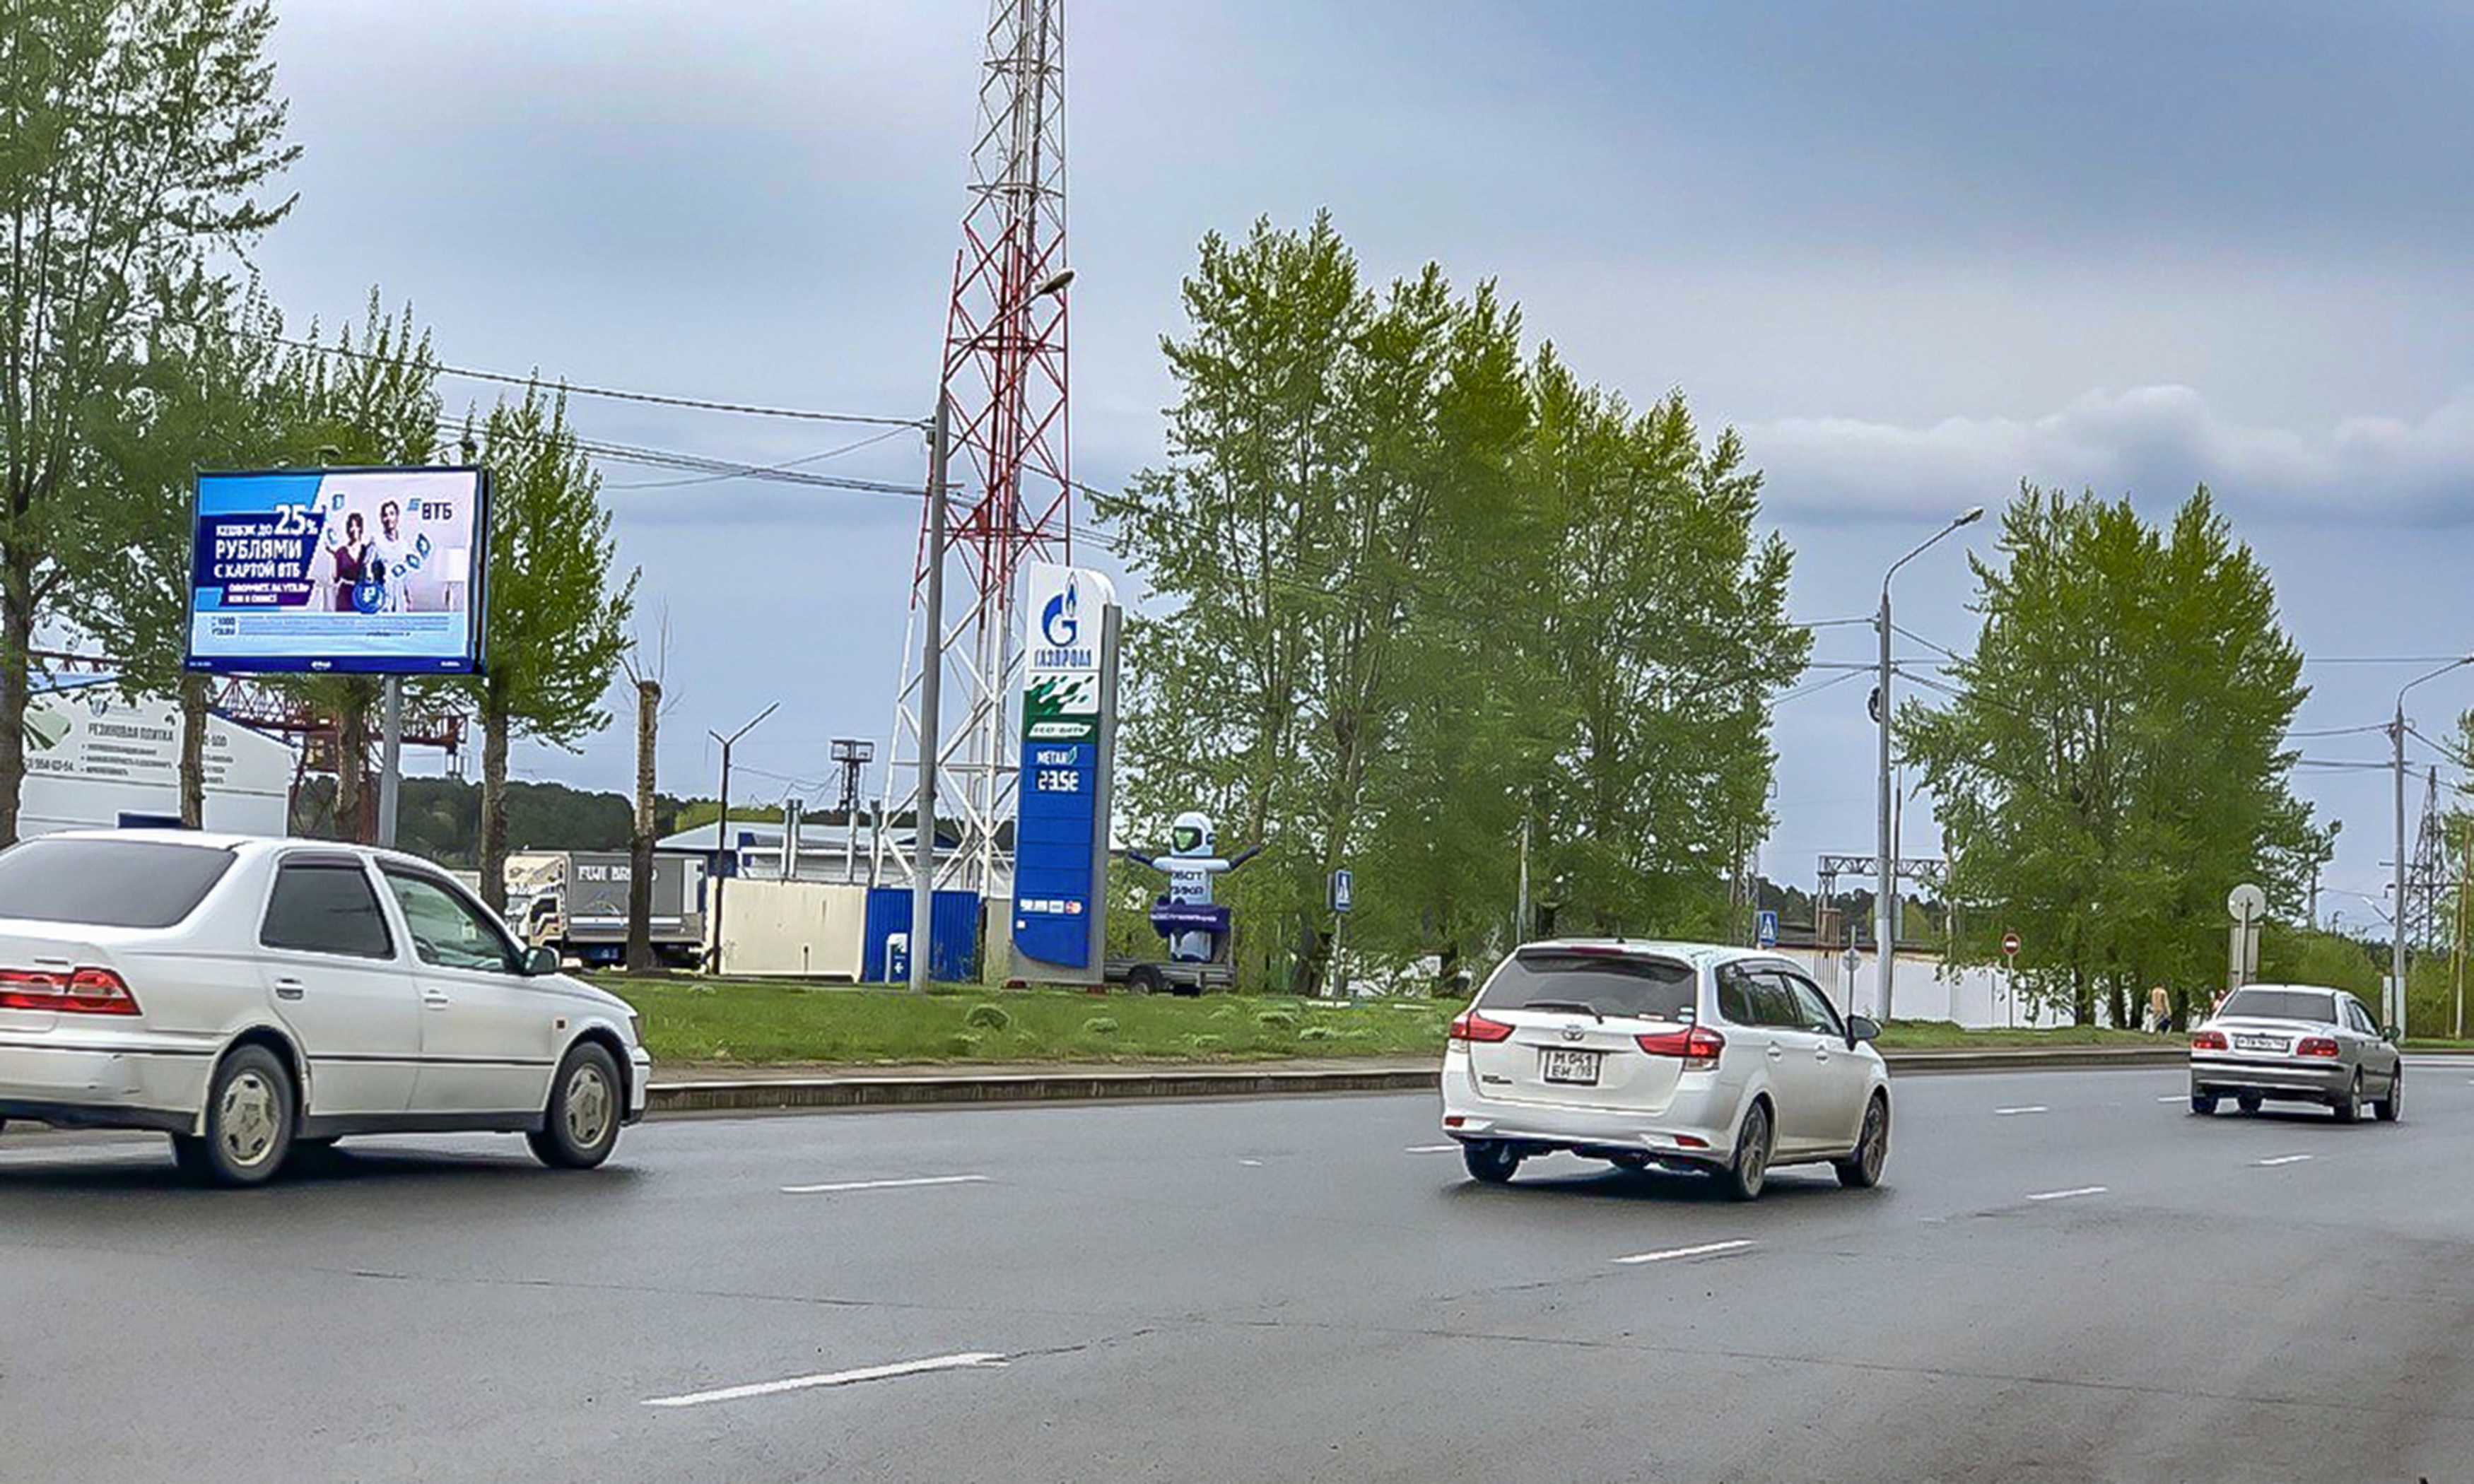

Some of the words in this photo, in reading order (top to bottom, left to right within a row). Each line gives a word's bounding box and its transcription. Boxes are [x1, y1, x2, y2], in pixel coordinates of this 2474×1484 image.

[274, 504, 318, 536] 25%
[422, 502, 452, 520] ВТБ
[215, 539, 302, 560] РУБЛЯМИ
[213, 565, 223, 578] С
[225, 560, 276, 578] КАРТОЙ
[278, 563, 301, 578] ВТБ
[1033, 648, 1091, 668] ГАЗПРОМ
[88, 722, 139, 738] РЕЗИНОВАЯ
[140, 726, 174, 742] ПЛИТКА
[1036, 750, 1069, 765] МЕТАН
[578, 865, 608, 881] FUJI
